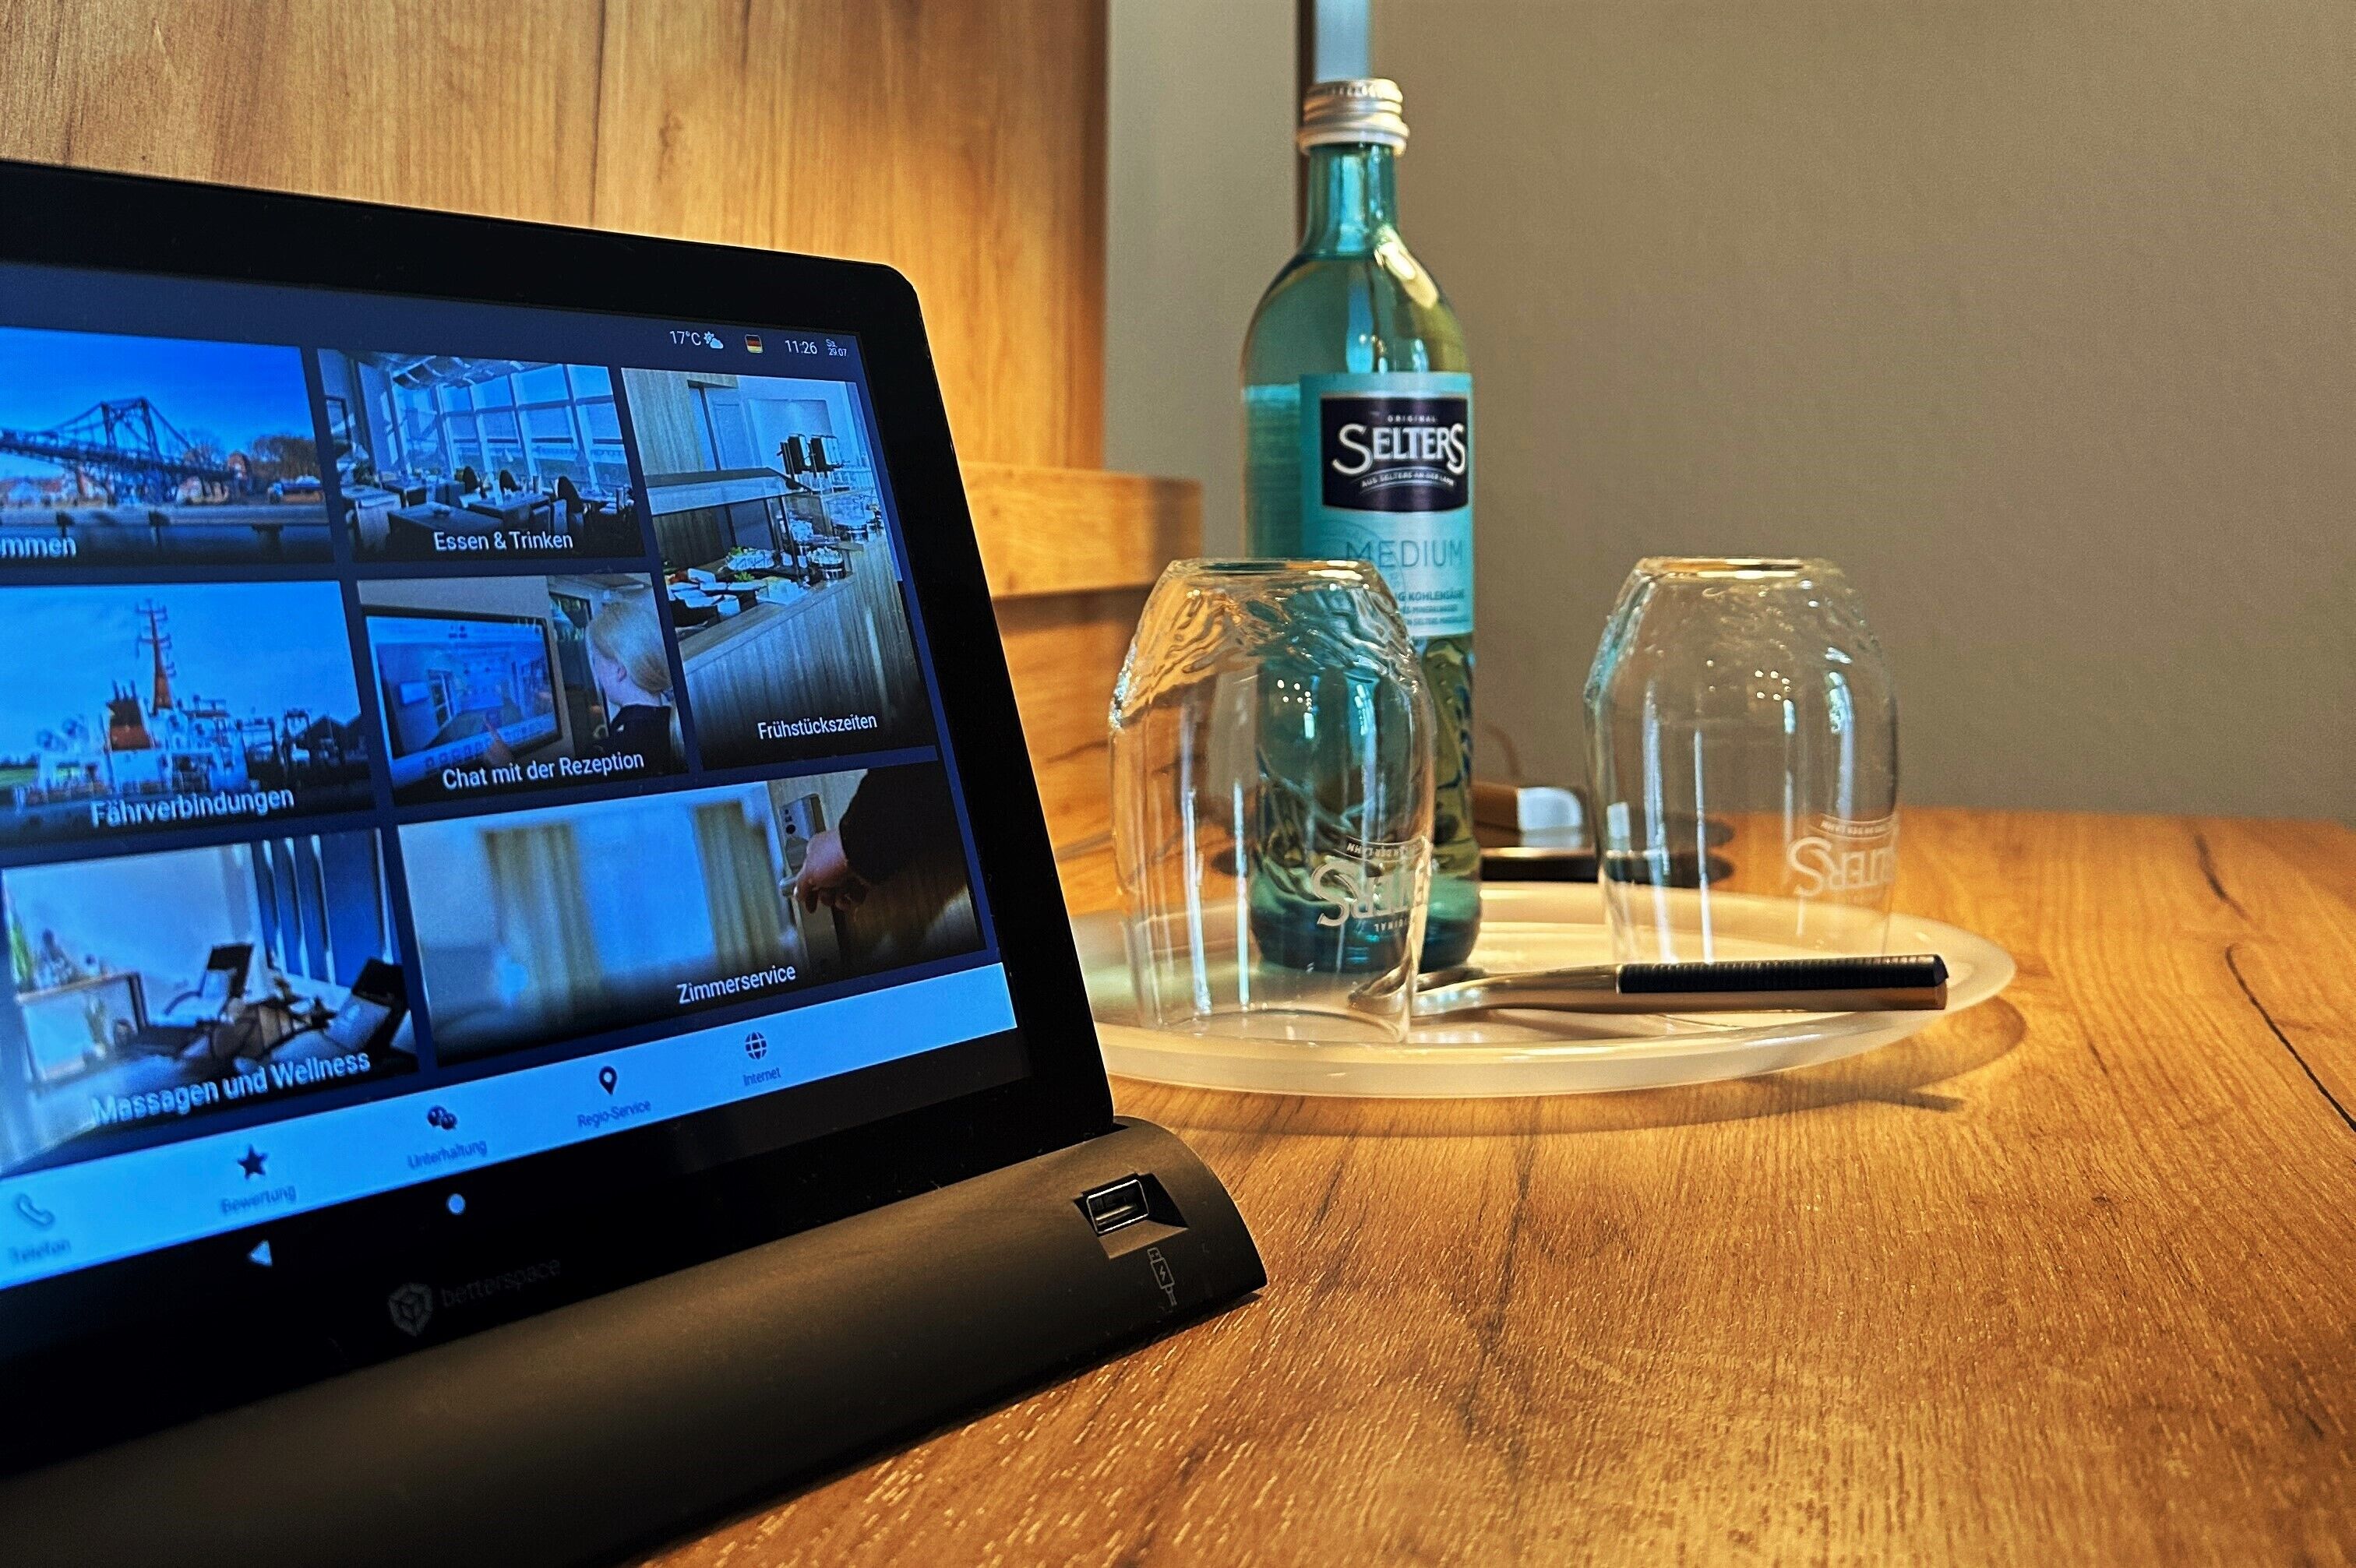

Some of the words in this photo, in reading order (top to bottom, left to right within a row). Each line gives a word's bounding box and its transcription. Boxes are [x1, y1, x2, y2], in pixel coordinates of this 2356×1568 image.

[669, 330, 702, 346] 17°C
[785, 340, 818, 354] 11:26
[1388, 414, 1437, 423] ORIGINAL
[1331, 423, 1465, 476] SELTERS
[432, 531, 490, 551] Essen
[493, 531, 507, 549] &
[509, 530, 574, 550] Trinken
[1346, 540, 1464, 567] MEDIUM
[757, 714, 879, 740] Frühstückszeiten
[443, 767, 488, 791] Chat
[492, 762, 524, 784] mit
[527, 759, 556, 780] der
[559, 751, 645, 777] Rezeption
[90, 789, 294, 828] Fährverbindungen
[676, 964, 797, 1005] Zimmerservice
[91, 1079, 220, 1125] Massagen
[223, 1065, 269, 1100] und
[270, 1052, 371, 1090] Wellness
[742, 1067, 781, 1087] Internet
[577, 1100, 651, 1129] Regio-Service
[407, 1140, 488, 1169] Unterhaltung
[220, 1185, 296, 1214] Bewertung
